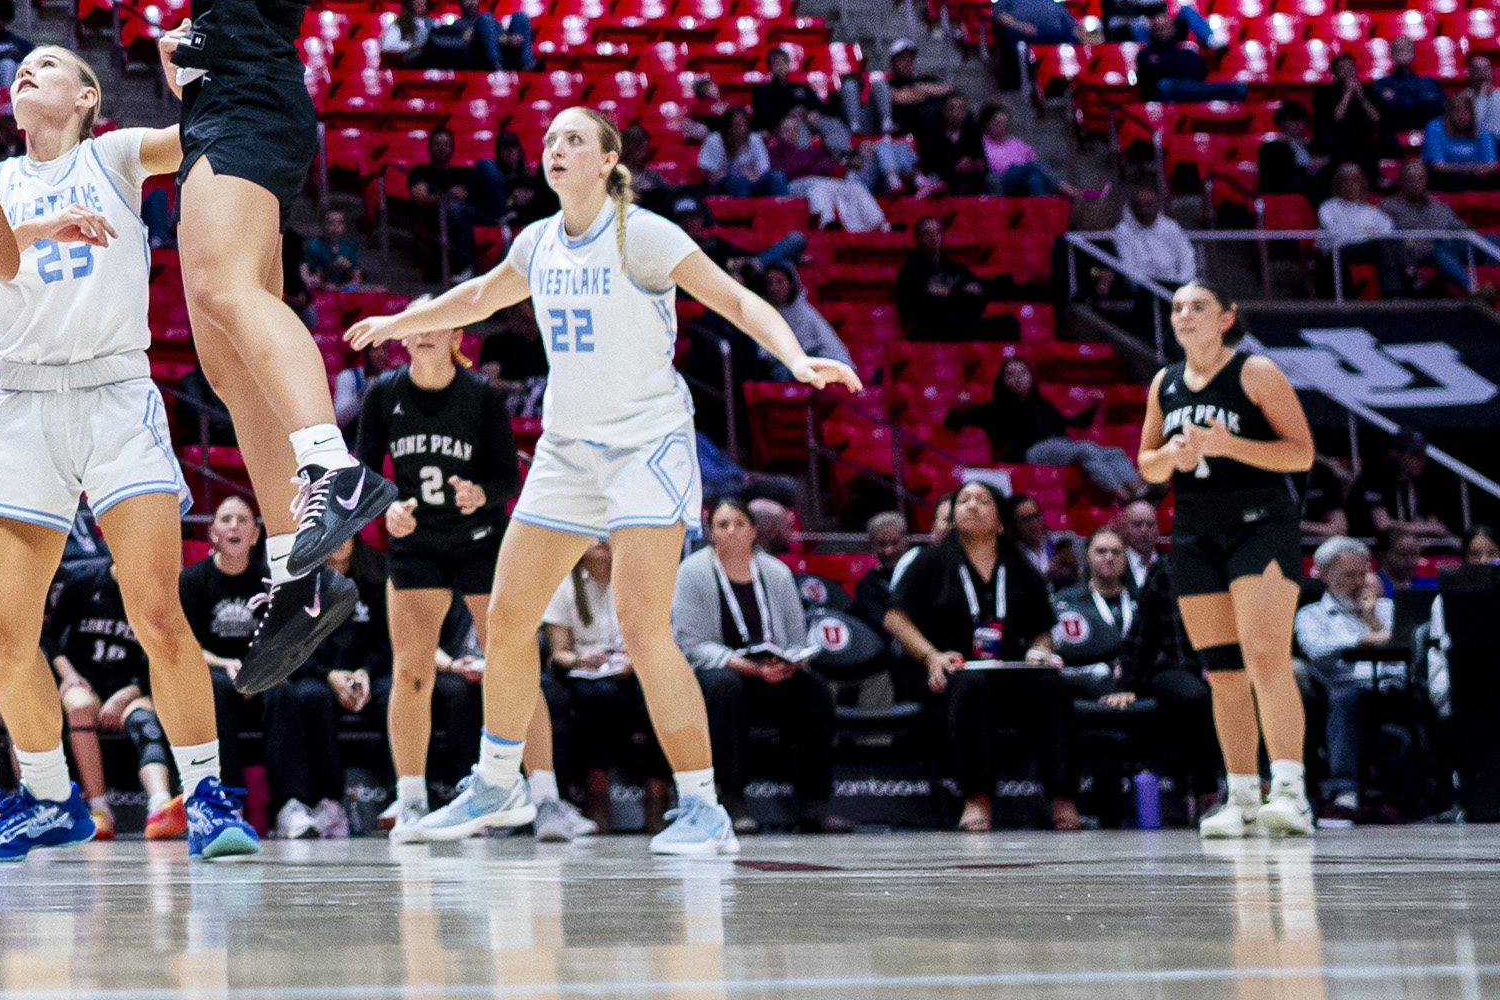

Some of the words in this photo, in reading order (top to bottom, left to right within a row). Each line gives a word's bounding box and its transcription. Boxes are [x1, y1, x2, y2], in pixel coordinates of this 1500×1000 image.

[33, 238, 95, 284] 23
[547, 308, 595, 353] 22
[389, 433, 427, 459] LONE
[419, 465, 445, 505] 2
[823, 626, 841, 645] U
[1062, 620, 1081, 637] U
